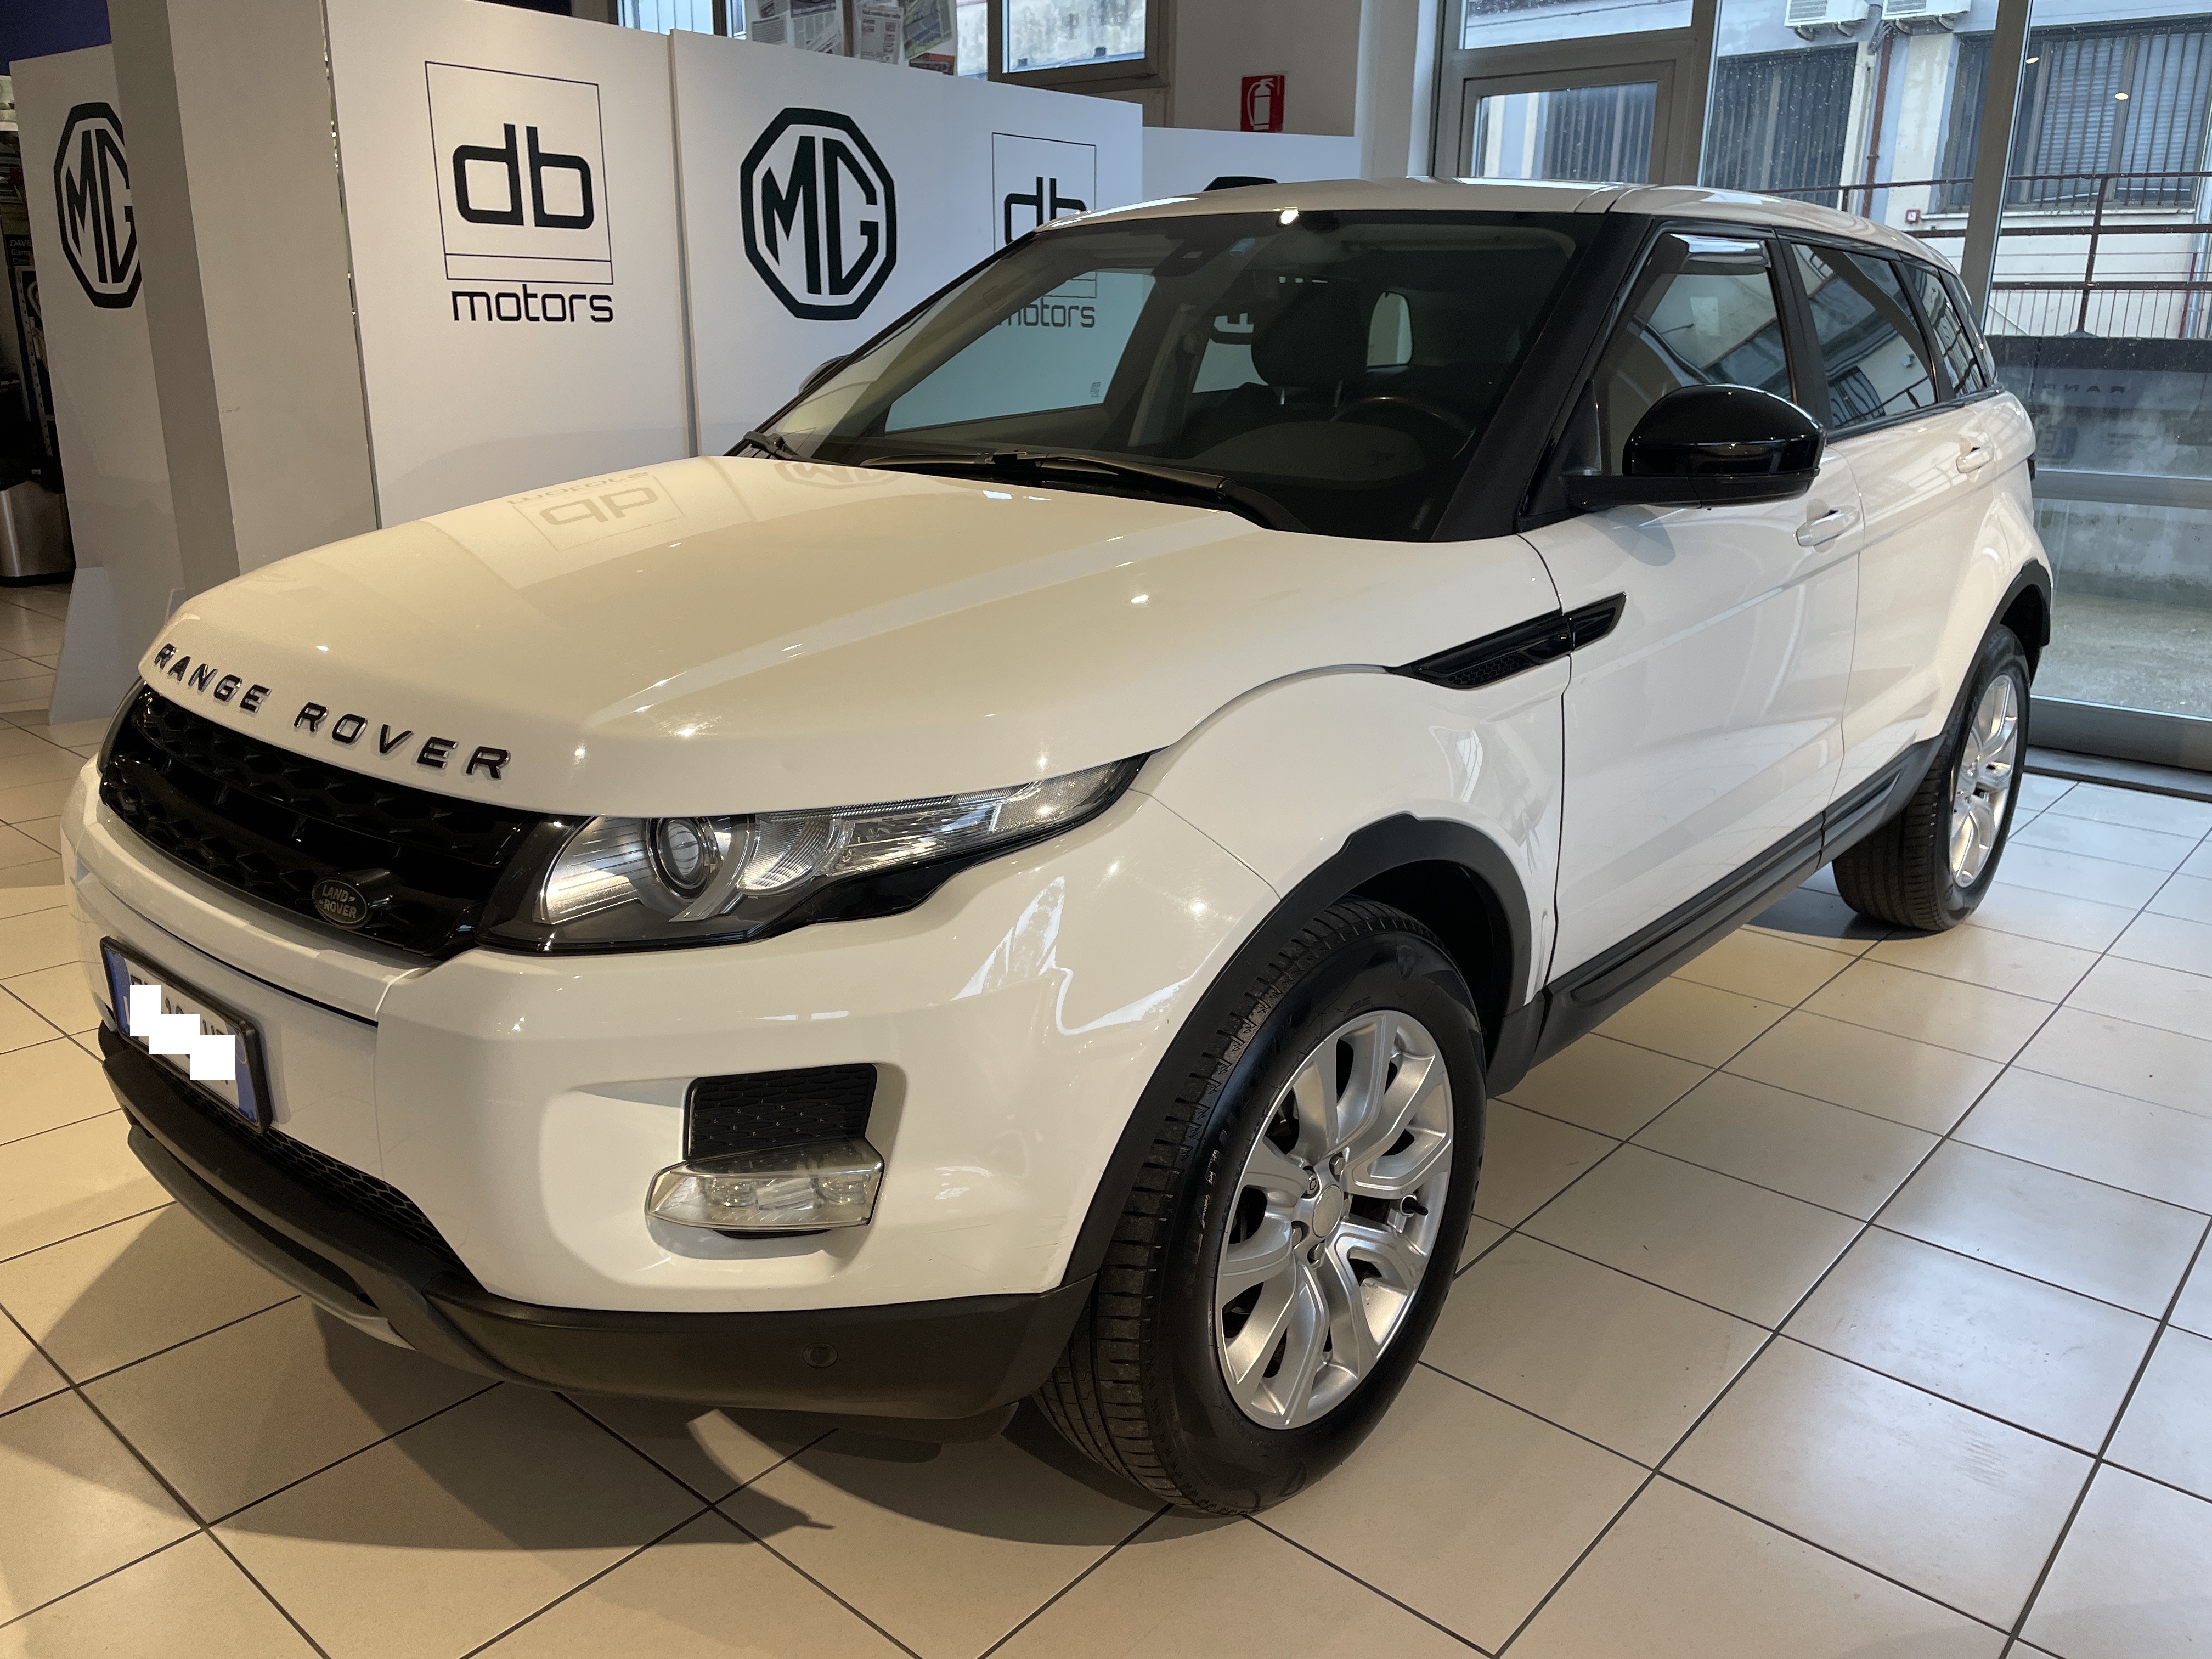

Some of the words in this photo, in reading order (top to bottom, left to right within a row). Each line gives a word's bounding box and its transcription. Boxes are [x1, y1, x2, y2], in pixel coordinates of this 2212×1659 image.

[452, 123, 594, 229] db
[761, 135, 879, 296] MG
[452, 284, 613, 323] motors
[998, 297, 1096, 328] otors
[153, 642, 272, 713] RANGE
[294, 701, 511, 780] ROVER
[321, 884, 349, 902] LAND
[324, 898, 358, 919] ROVER
